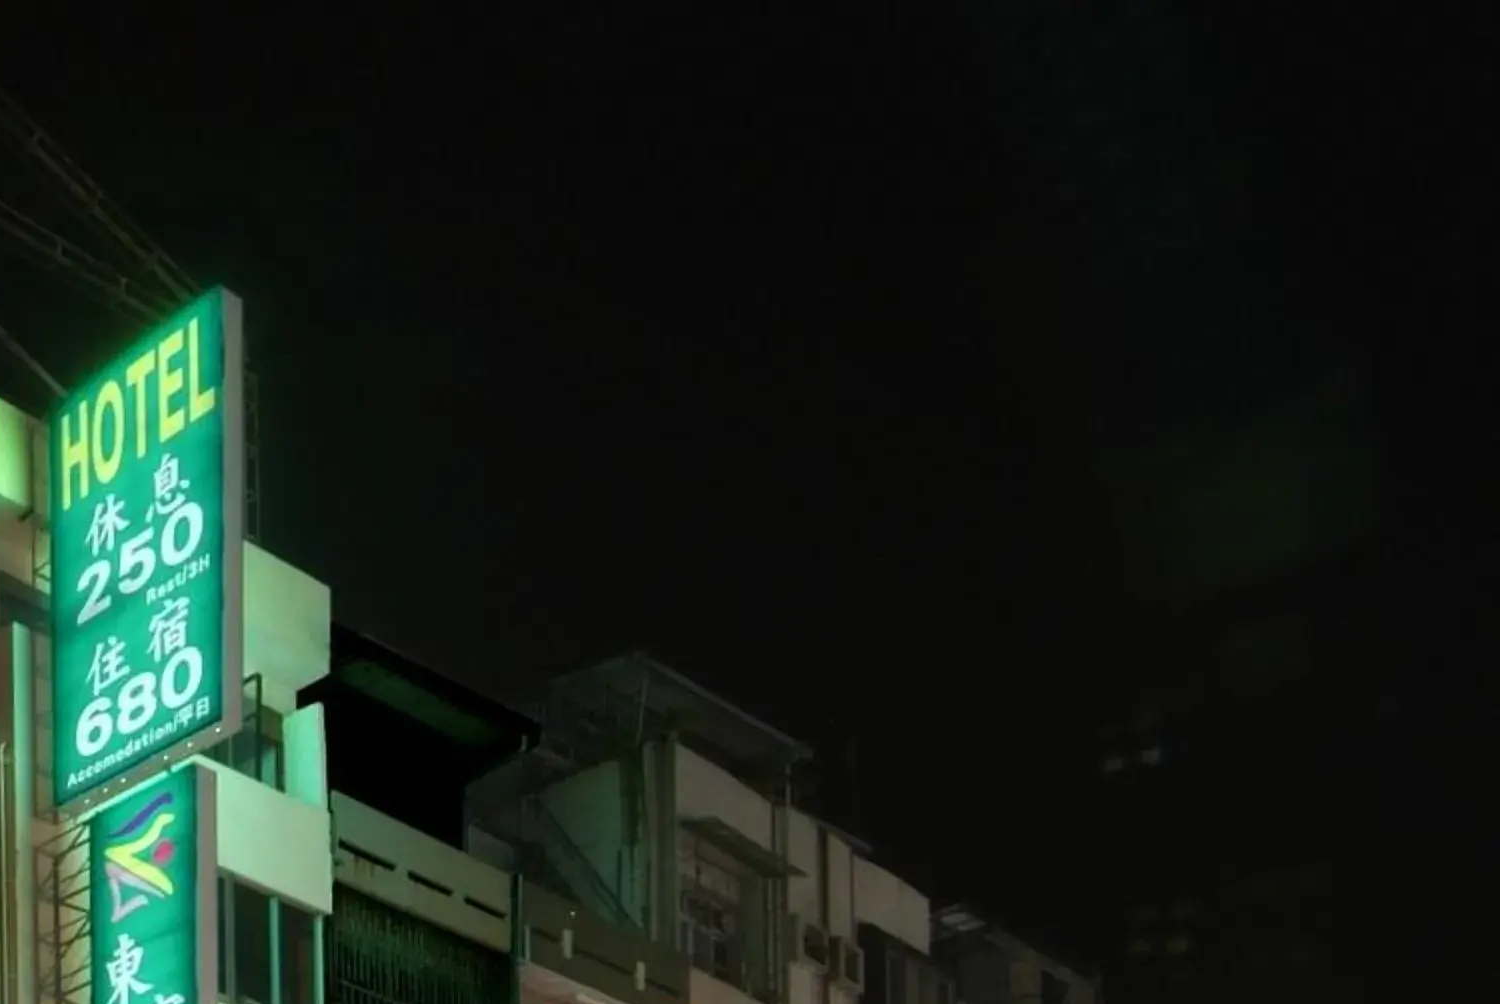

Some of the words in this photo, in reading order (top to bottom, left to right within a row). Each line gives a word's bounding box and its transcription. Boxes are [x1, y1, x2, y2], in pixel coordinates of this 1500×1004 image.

[60, 317, 216, 511] HOTEL
[85, 453, 190, 556] 休息
[76, 502, 204, 627] 250
[75, 646, 203, 757] 680
[85, 596, 191, 696] 住宿
